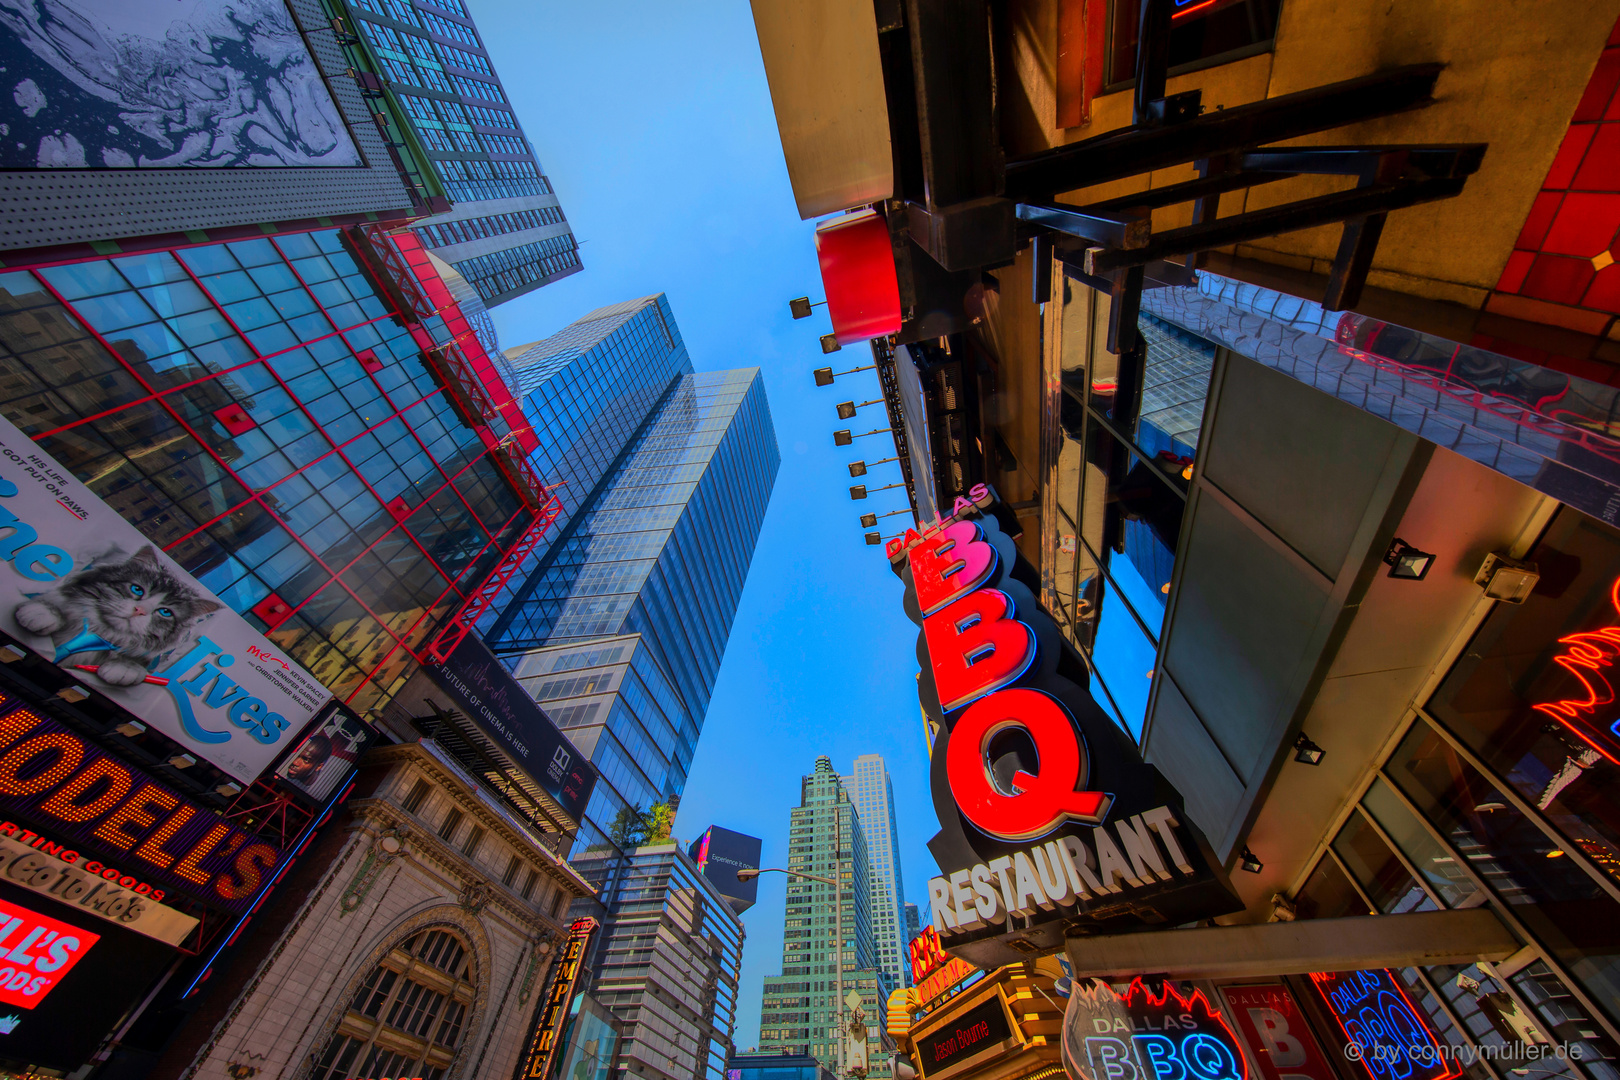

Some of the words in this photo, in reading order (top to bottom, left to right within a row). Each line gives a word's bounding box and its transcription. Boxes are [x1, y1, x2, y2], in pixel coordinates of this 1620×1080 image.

[3, 448, 28, 466] GOT
[24, 466, 48, 482] PUT
[45, 483, 63, 496] ON
[60, 495, 89, 520] PAWS.
[27, 454, 47, 469] HIS
[45, 468, 69, 487] LIFE
[0, 474, 74, 582] ne
[885, 482, 990, 561] DALLAS
[155, 635, 292, 745] Lives
[255, 665, 293, 696] CHRISTOPHER
[291, 693, 315, 713] WALKEN
[273, 669, 300, 690] JENNIFER
[298, 688, 320, 707] GARNER
[290, 670, 308, 686] KEVIN
[305, 684, 326, 700] SPACEY
[909, 519, 1113, 841] BBQ
[441, 666, 471, 698] FUTURE
[469, 695, 482, 707] OF
[480, 705, 506, 735] CINEMA
[504, 730, 514, 741] IS
[512, 738, 530, 758] HERE
[0, 821, 80, 864] RTING
[85, 861, 166, 902] GOODS
[711, 853, 739, 867] Experience
[928, 805, 1194, 937] RESTAURANT
[920, 957, 971, 1004] CINEMA
[1228, 992, 1292, 1006] DALLAS
[1331, 969, 1381, 1015] DALLAS
[529, 941, 582, 1078] EMPIRE
[1092, 1013, 1198, 1034] DALLAS
[934, 1036, 959, 1062] Jason
[955, 1020, 989, 1050] Bourne
[1085, 1033, 1243, 1080] BBQ
